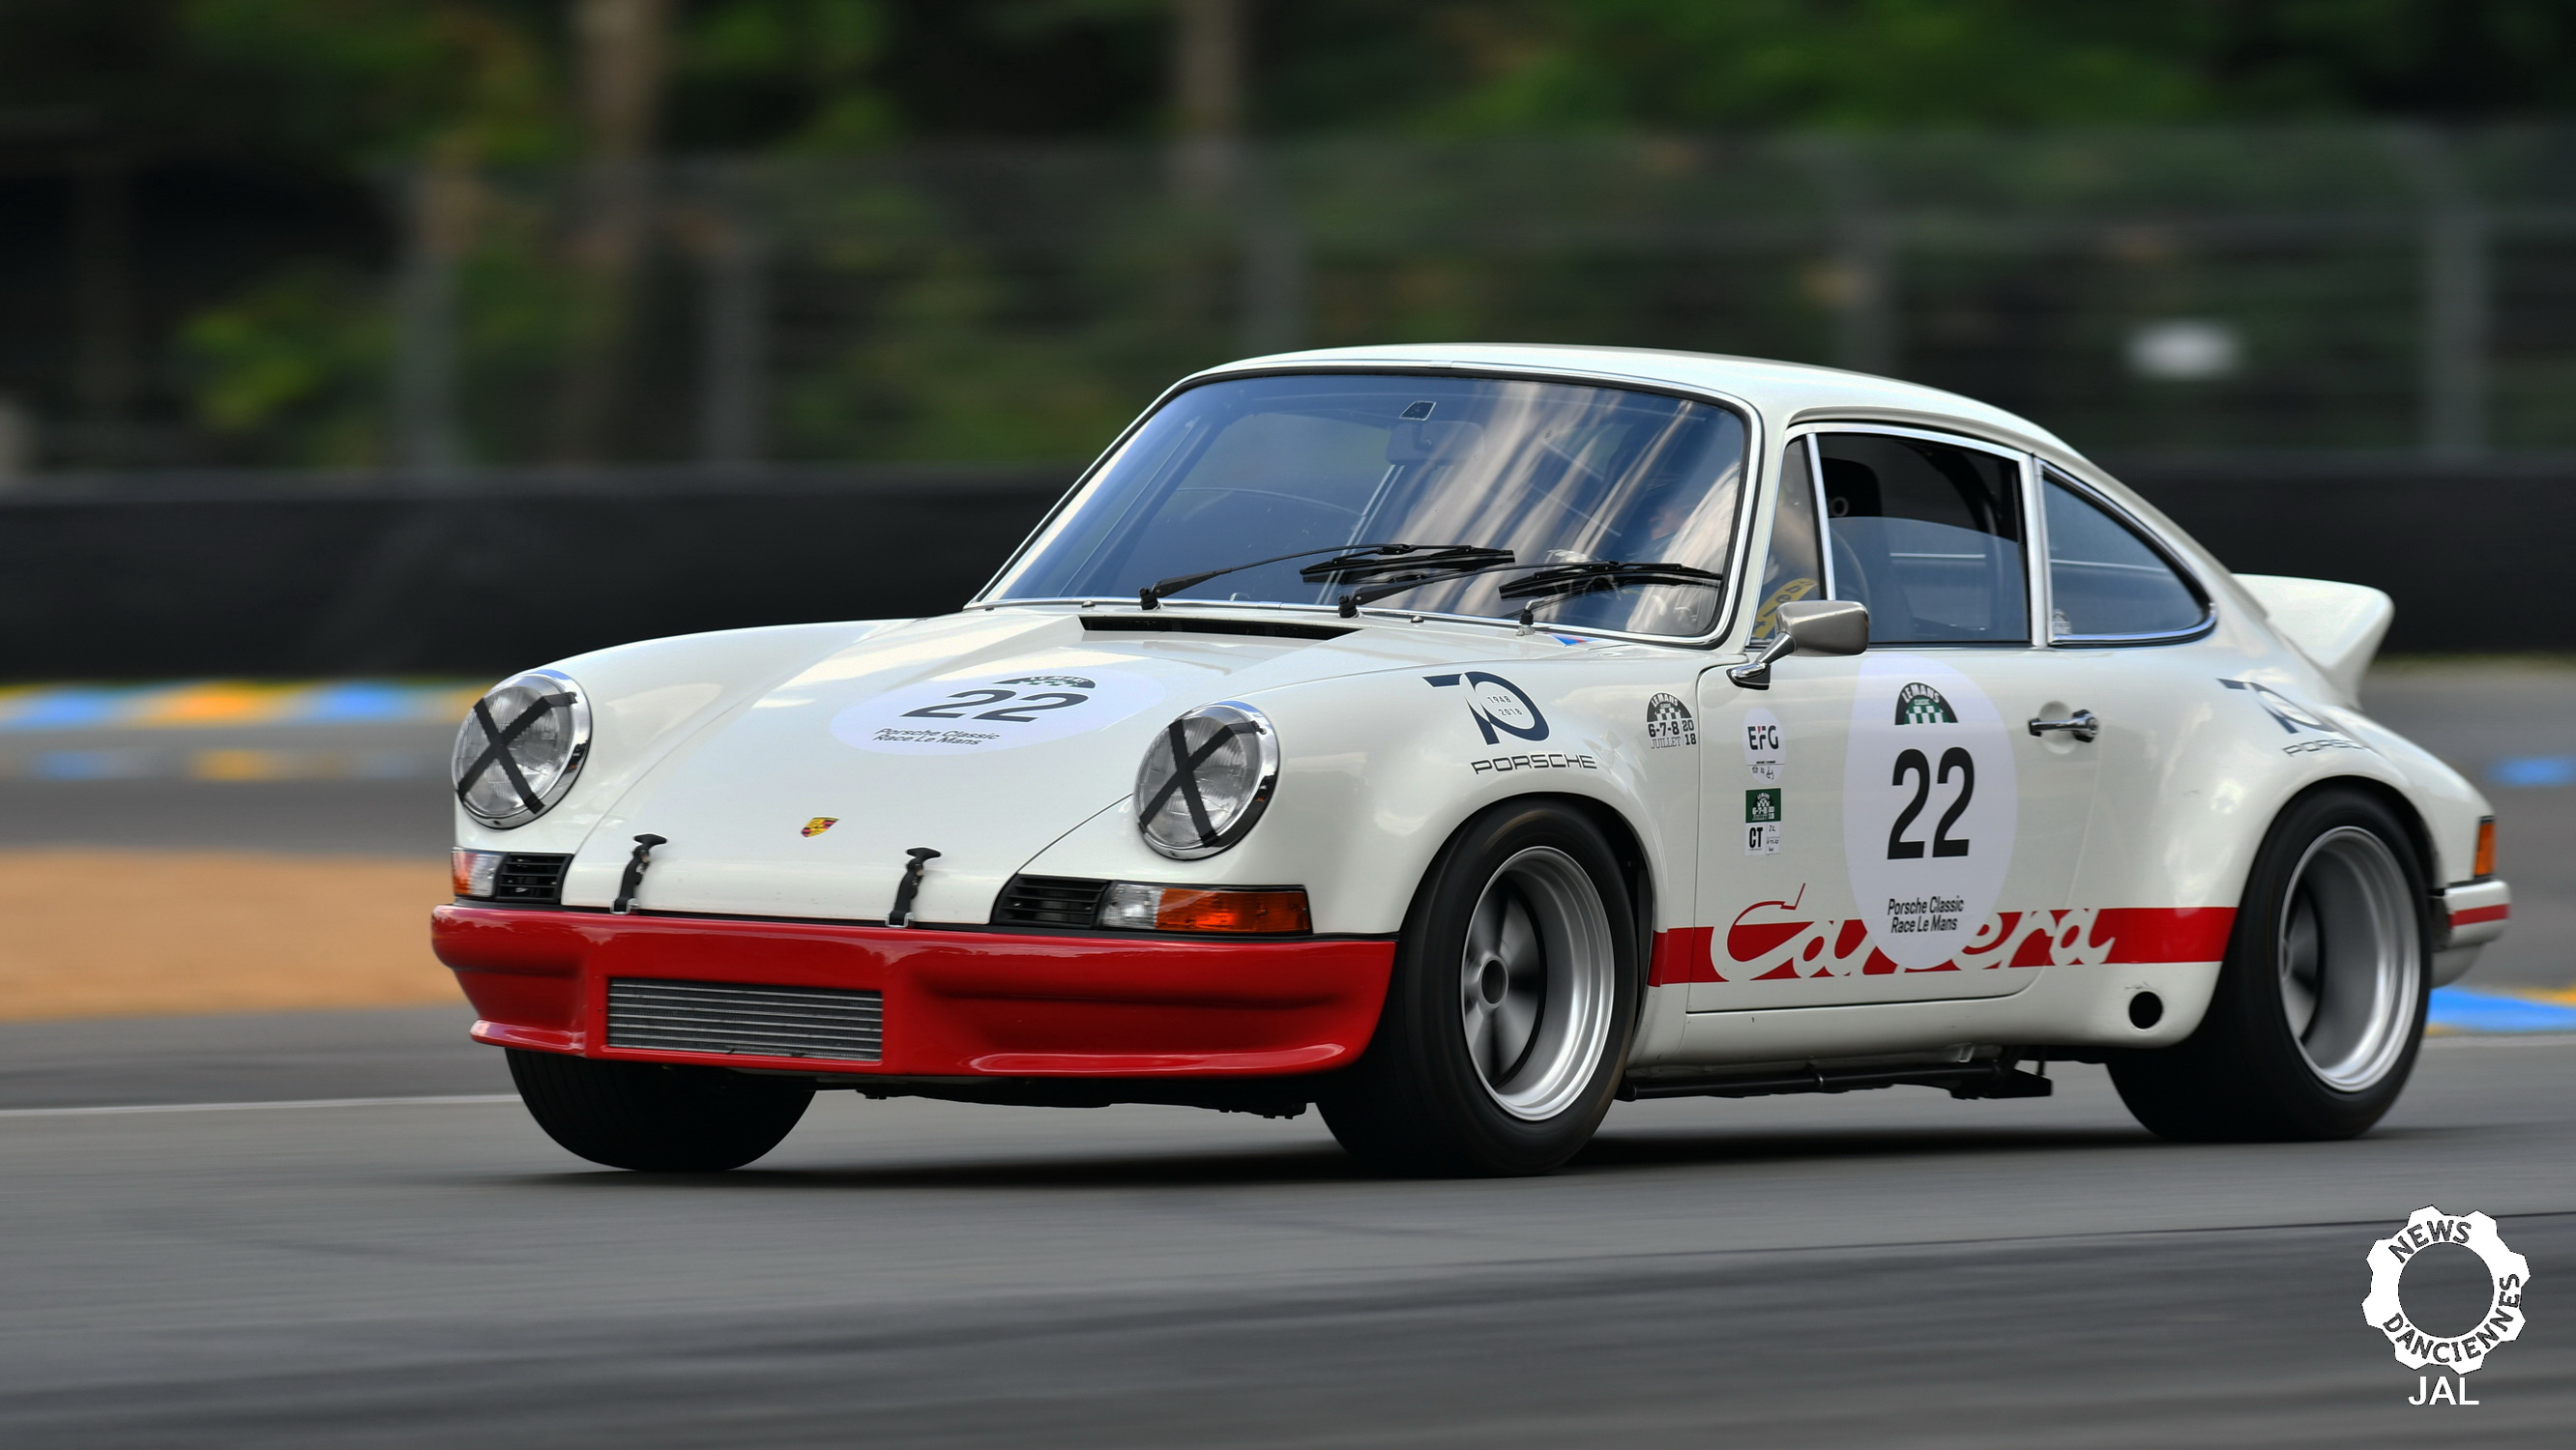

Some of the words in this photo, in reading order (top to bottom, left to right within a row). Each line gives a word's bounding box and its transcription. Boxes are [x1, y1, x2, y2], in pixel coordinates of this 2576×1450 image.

[899, 689, 1089, 723] 22
[1487, 695, 1511, 704] 1948
[1498, 708, 1523, 716] 2018
[874, 728, 941, 737] Porsche
[942, 730, 1001, 740] Classic
[1648, 720, 1680, 738] 6-7-8
[1682, 719, 1695, 732] 20
[1747, 725, 1779, 750] EFG
[936, 737, 982, 745] Mans
[1651, 736, 1682, 749] JUILLET
[1684, 733, 1697, 745] 18
[2282, 739, 2363, 757] PORS
[1471, 754, 1597, 774] PORSCHE
[1887, 746, 1975, 859] 22
[1749, 826, 1764, 849] CT
[1888, 897, 1928, 915] Porsche
[1929, 895, 1965, 914] Classic
[1711, 883, 2116, 984] Caera
[1890, 916, 1916, 934] Race
[1917, 915, 1929, 933] Le
[1930, 914, 1958, 932] Mans
